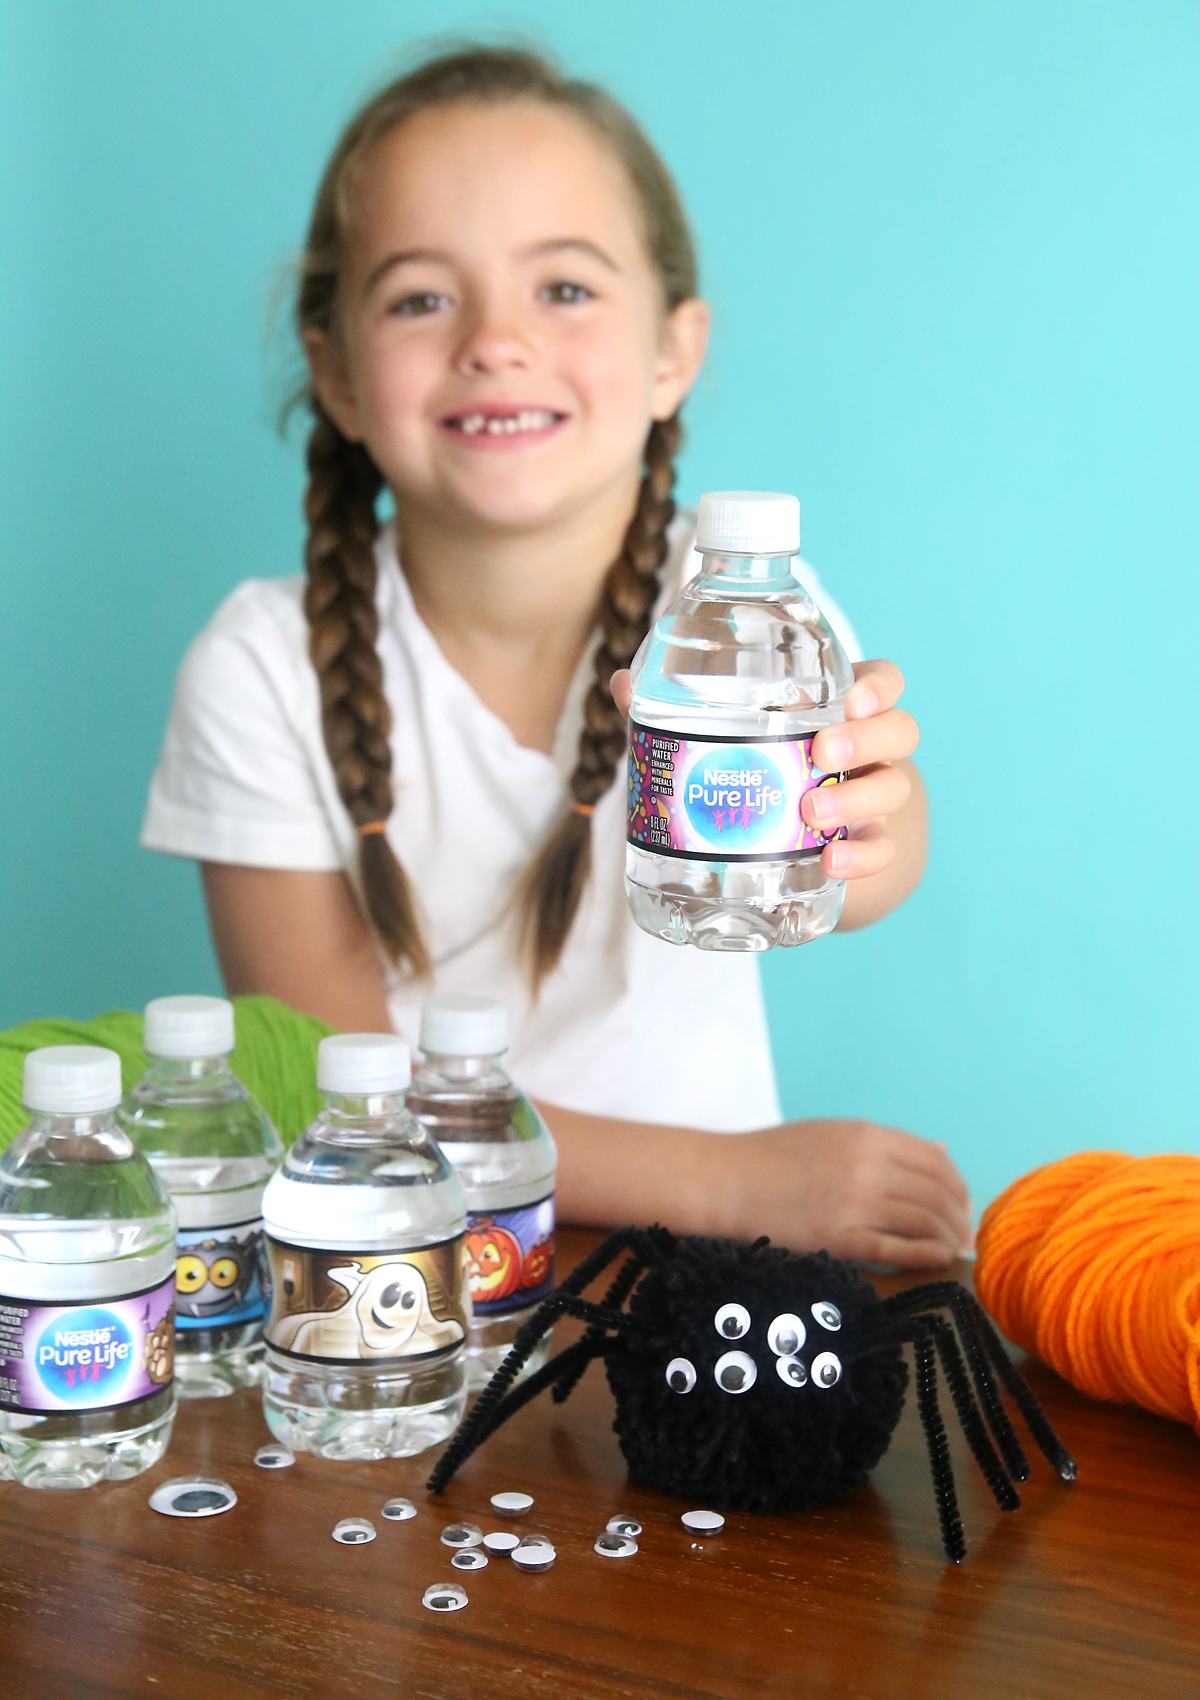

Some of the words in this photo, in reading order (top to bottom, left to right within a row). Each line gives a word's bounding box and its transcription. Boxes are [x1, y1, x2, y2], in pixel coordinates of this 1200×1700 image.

[652, 738, 679, 752] PURIFIED
[652, 749, 671, 761] WATER
[651, 759, 675, 771] ENHANCED
[651, 776, 672, 787] MINERALS
[660, 787, 673, 796] TASTE
[688, 784, 742, 807] Pure
[745, 785, 782, 815] Life
[39, 1346, 92, 1366] Pure
[95, 1341, 129, 1369] Life
